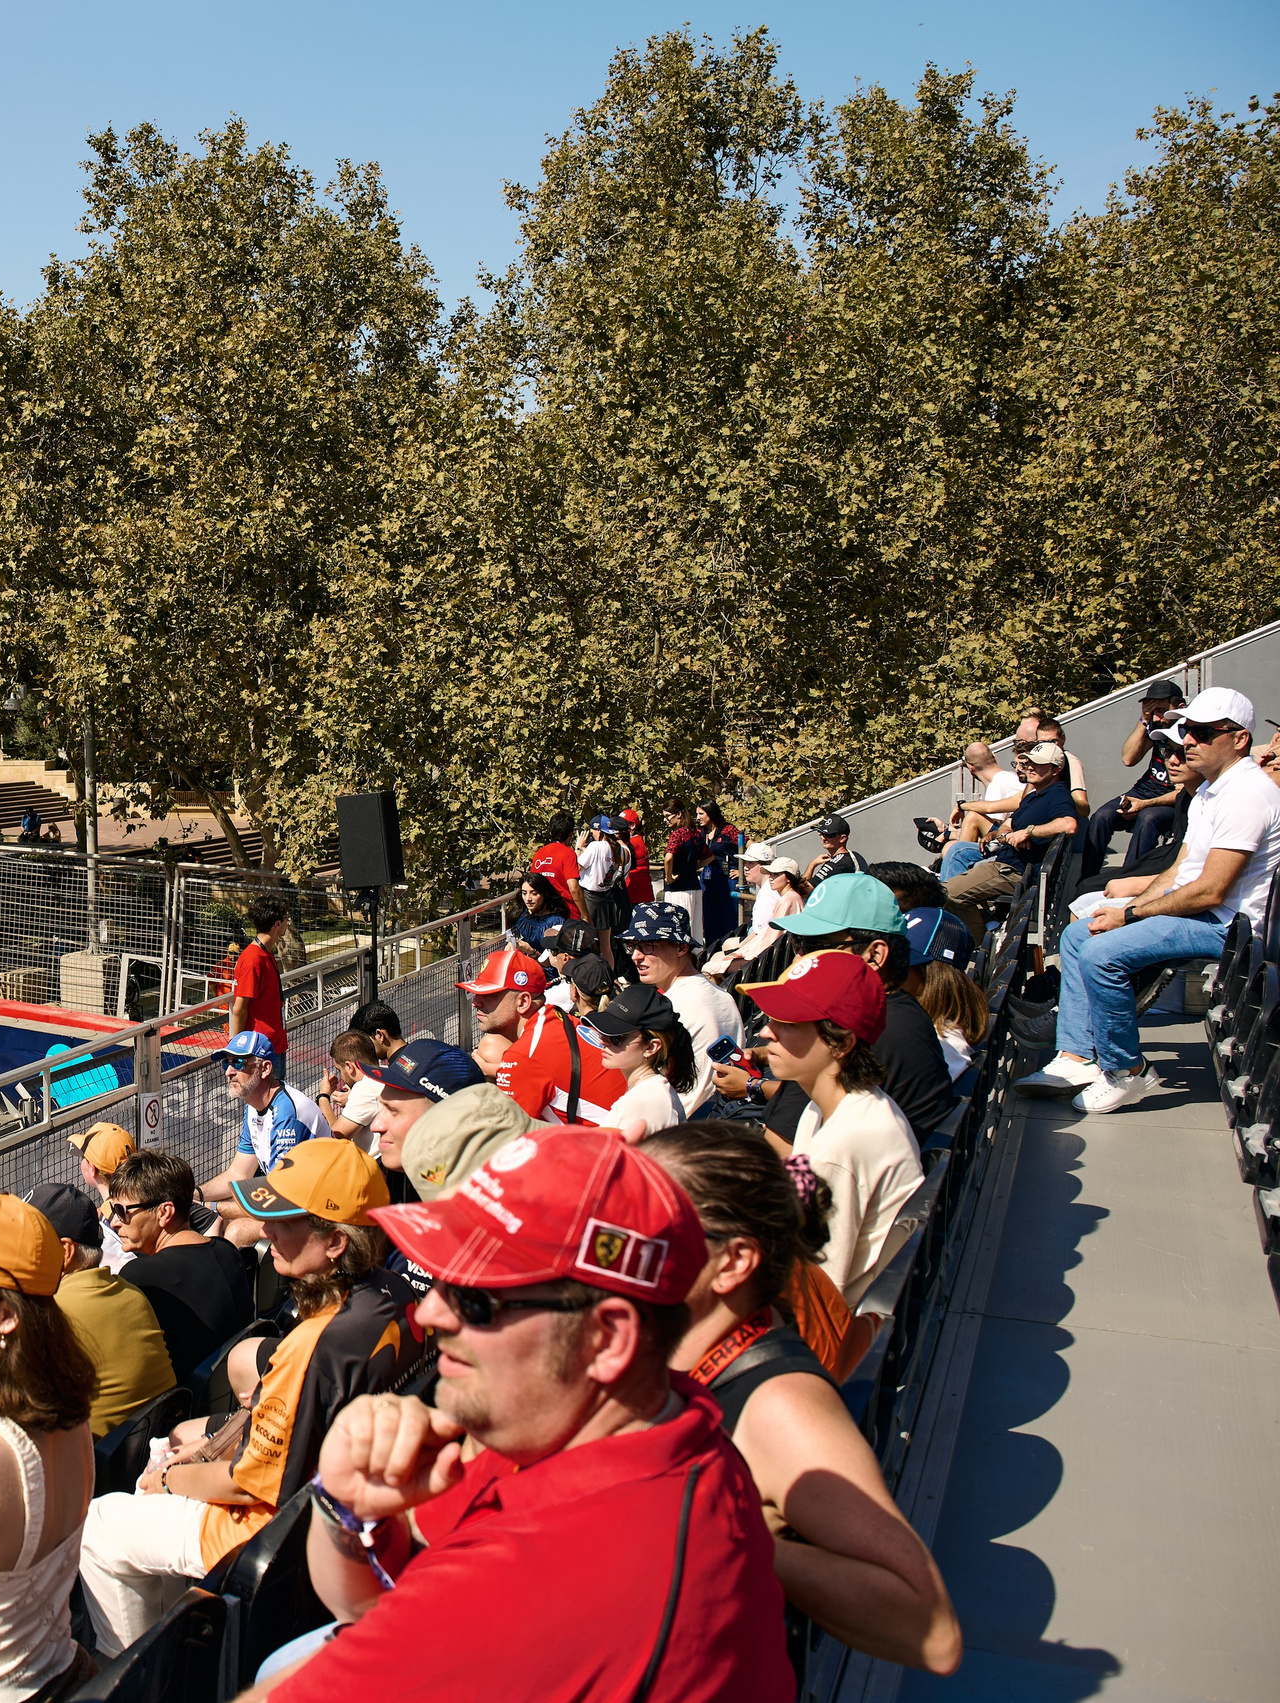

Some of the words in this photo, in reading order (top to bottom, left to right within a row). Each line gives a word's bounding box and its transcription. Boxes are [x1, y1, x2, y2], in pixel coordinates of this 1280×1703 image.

[419, 1077, 450, 1099] CarNe
[276, 1128, 296, 1138] VISA
[251, 1187, 278, 1208] 81
[407, 1259, 433, 1280] VISA
[635, 1243, 655, 1281] 1
[410, 1279, 431, 1292] AT&T
[255, 1424, 284, 1446] ECOLAB
